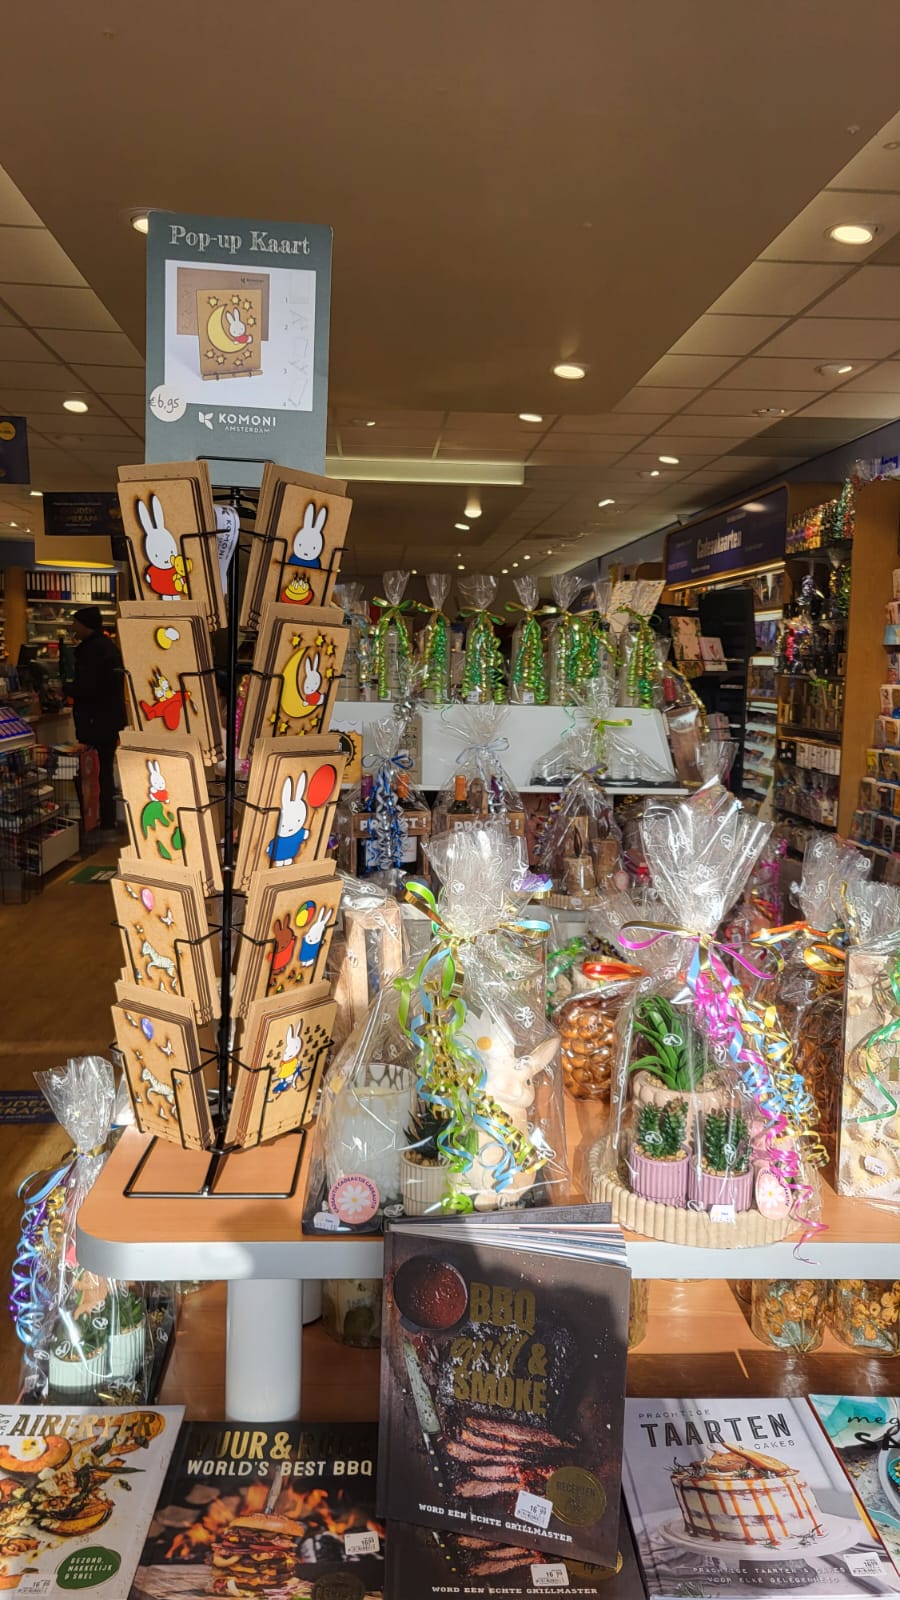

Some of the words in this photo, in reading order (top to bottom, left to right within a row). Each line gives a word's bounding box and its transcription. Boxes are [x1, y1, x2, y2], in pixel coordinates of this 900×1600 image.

[168, 225, 242, 254] Pop-up
[249, 231, 310, 255] Kaart
[219, 413, 276, 427] KOMONI
[225, 426, 270, 434] AMSTERDAM
[470, 1282, 536, 1335] BBQ
[528, 1343, 547, 1377] &
[454, 1368, 548, 1416] SMOKE
[6, 1413, 155, 1438] AIRFRYER
[640, 1413, 792, 1447] TAARTEN
[269, 1431, 292, 1460] &
[754, 1440, 795, 1450] CAKES
[187, 1460, 270, 1477] WORLD'S
[281, 1461, 326, 1477] BEST
[333, 1460, 373, 1477] BBQ
[418, 1503, 445, 1515] WORD
[448, 1509, 467, 1520] EEN
[470, 1514, 502, 1527] ECHTE
[505, 1521, 573, 1542] GRILLMASTER
[67, 1564, 113, 1572] MAKKELIJK
[73, 1572, 93, 1580] SNEL
[431, 1586, 460, 1594] WORD
[488, 1587, 522, 1595] ECHTE
